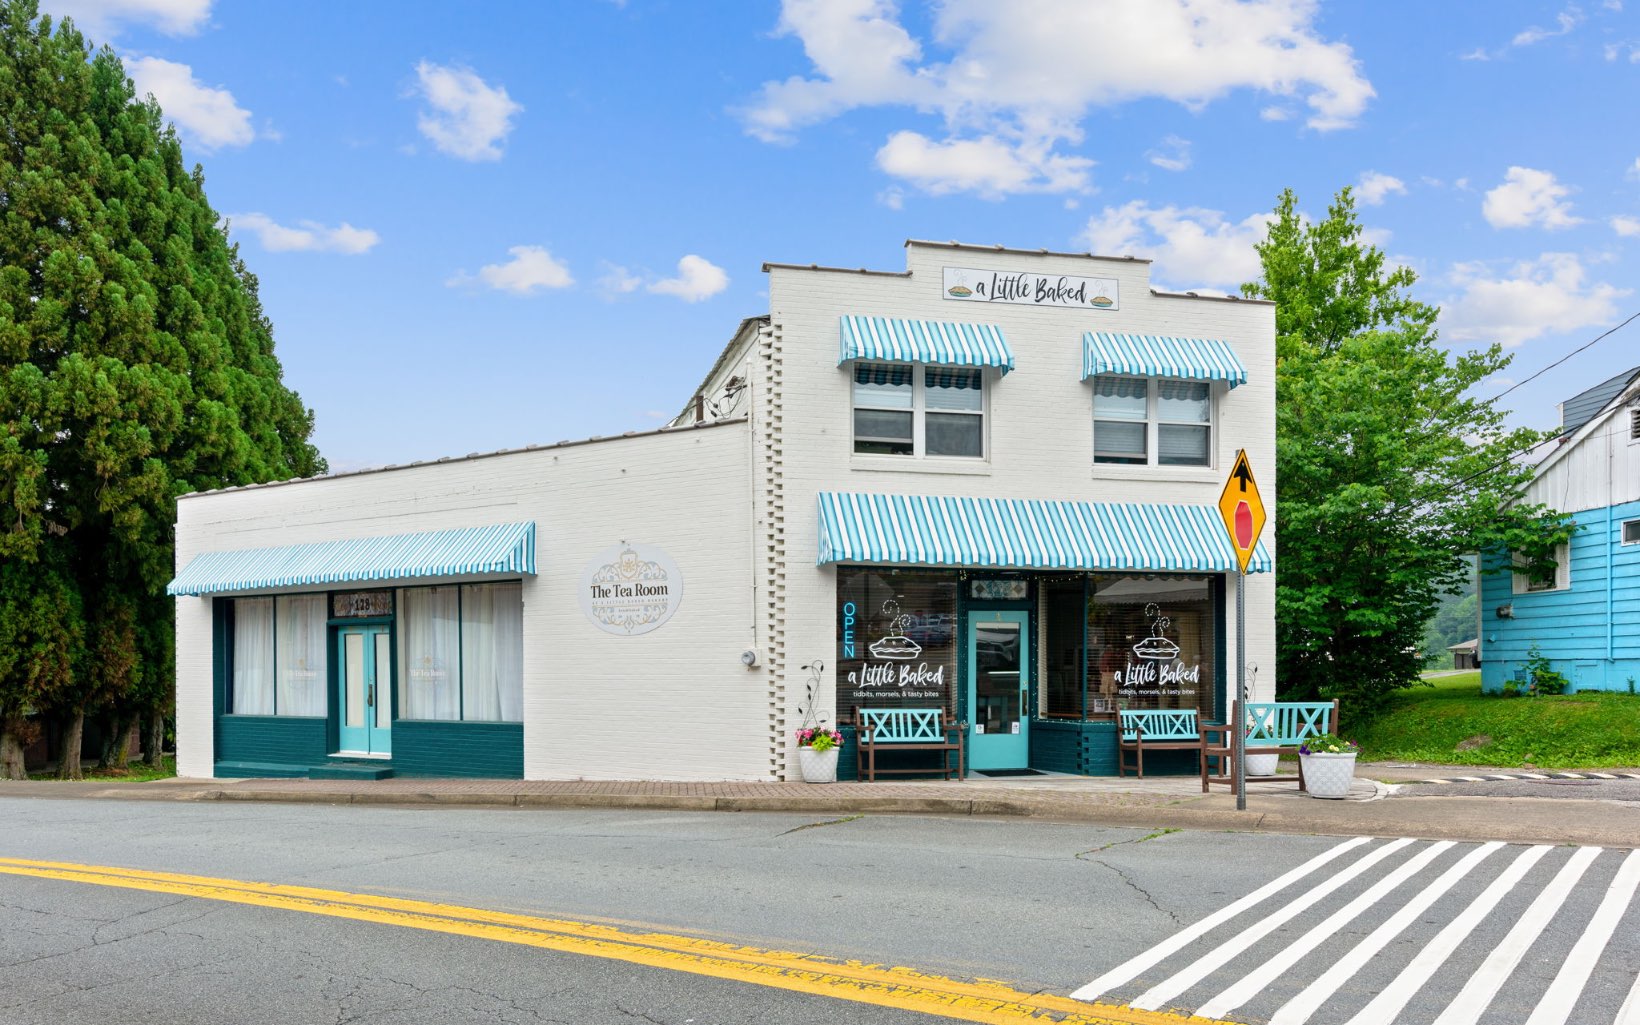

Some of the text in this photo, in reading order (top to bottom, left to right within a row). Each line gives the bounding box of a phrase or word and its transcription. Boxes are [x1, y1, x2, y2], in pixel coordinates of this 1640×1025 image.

[976, 272, 1087, 304] a Little Baked
[590, 583, 668, 599] The Tea Room
[843, 602, 856, 659] OPEN
[848, 661, 944, 688] a Little Baked
[1114, 661, 1200, 686] a Little Baked
